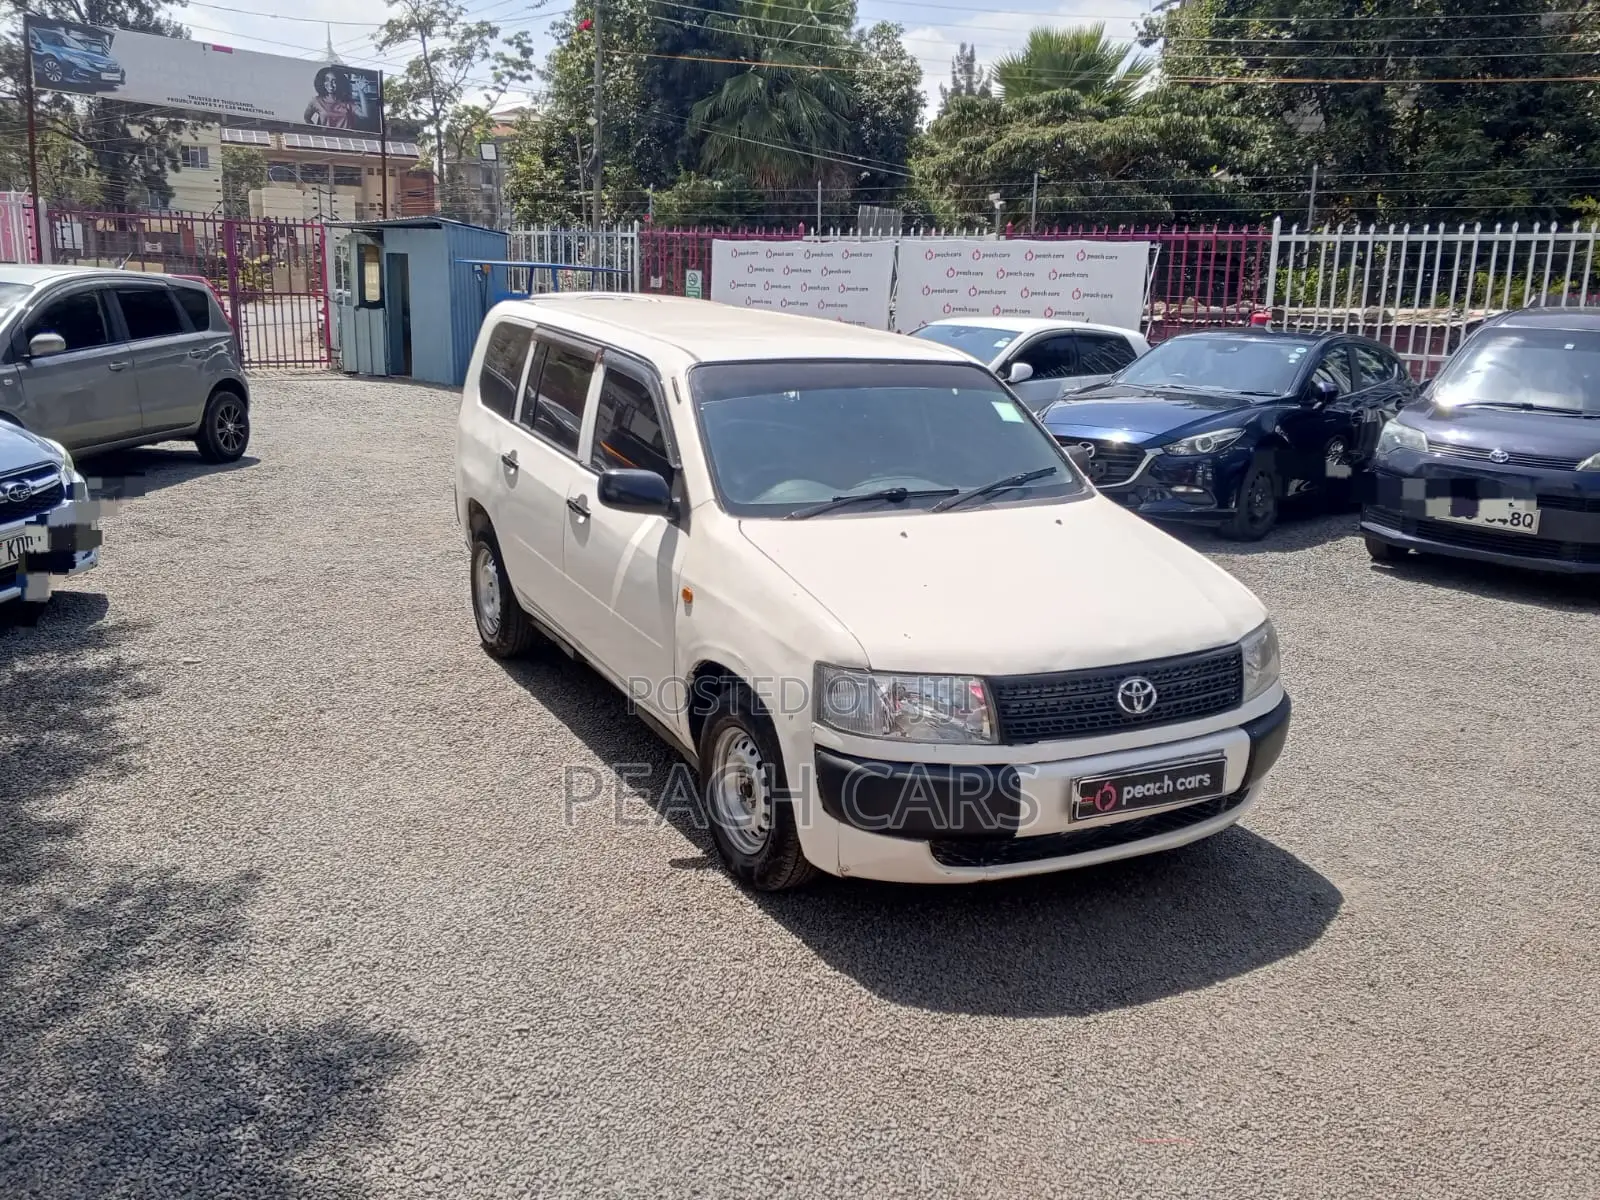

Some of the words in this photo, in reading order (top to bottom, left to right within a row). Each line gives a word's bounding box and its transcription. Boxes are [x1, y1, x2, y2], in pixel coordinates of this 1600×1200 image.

[187, 95, 212, 103] TRUSTED
[167, 97, 193, 105] PROUDLY
[237, 107, 275, 116] MARKETPLACE
[956, 270, 972, 278] peach
[1006, 270, 1022, 278] peach
[1058, 272, 1075, 280] peach
[978, 288, 994, 296] peach
[1121, 774, 1173, 806] peach
[1175, 773, 1212, 789] cars
